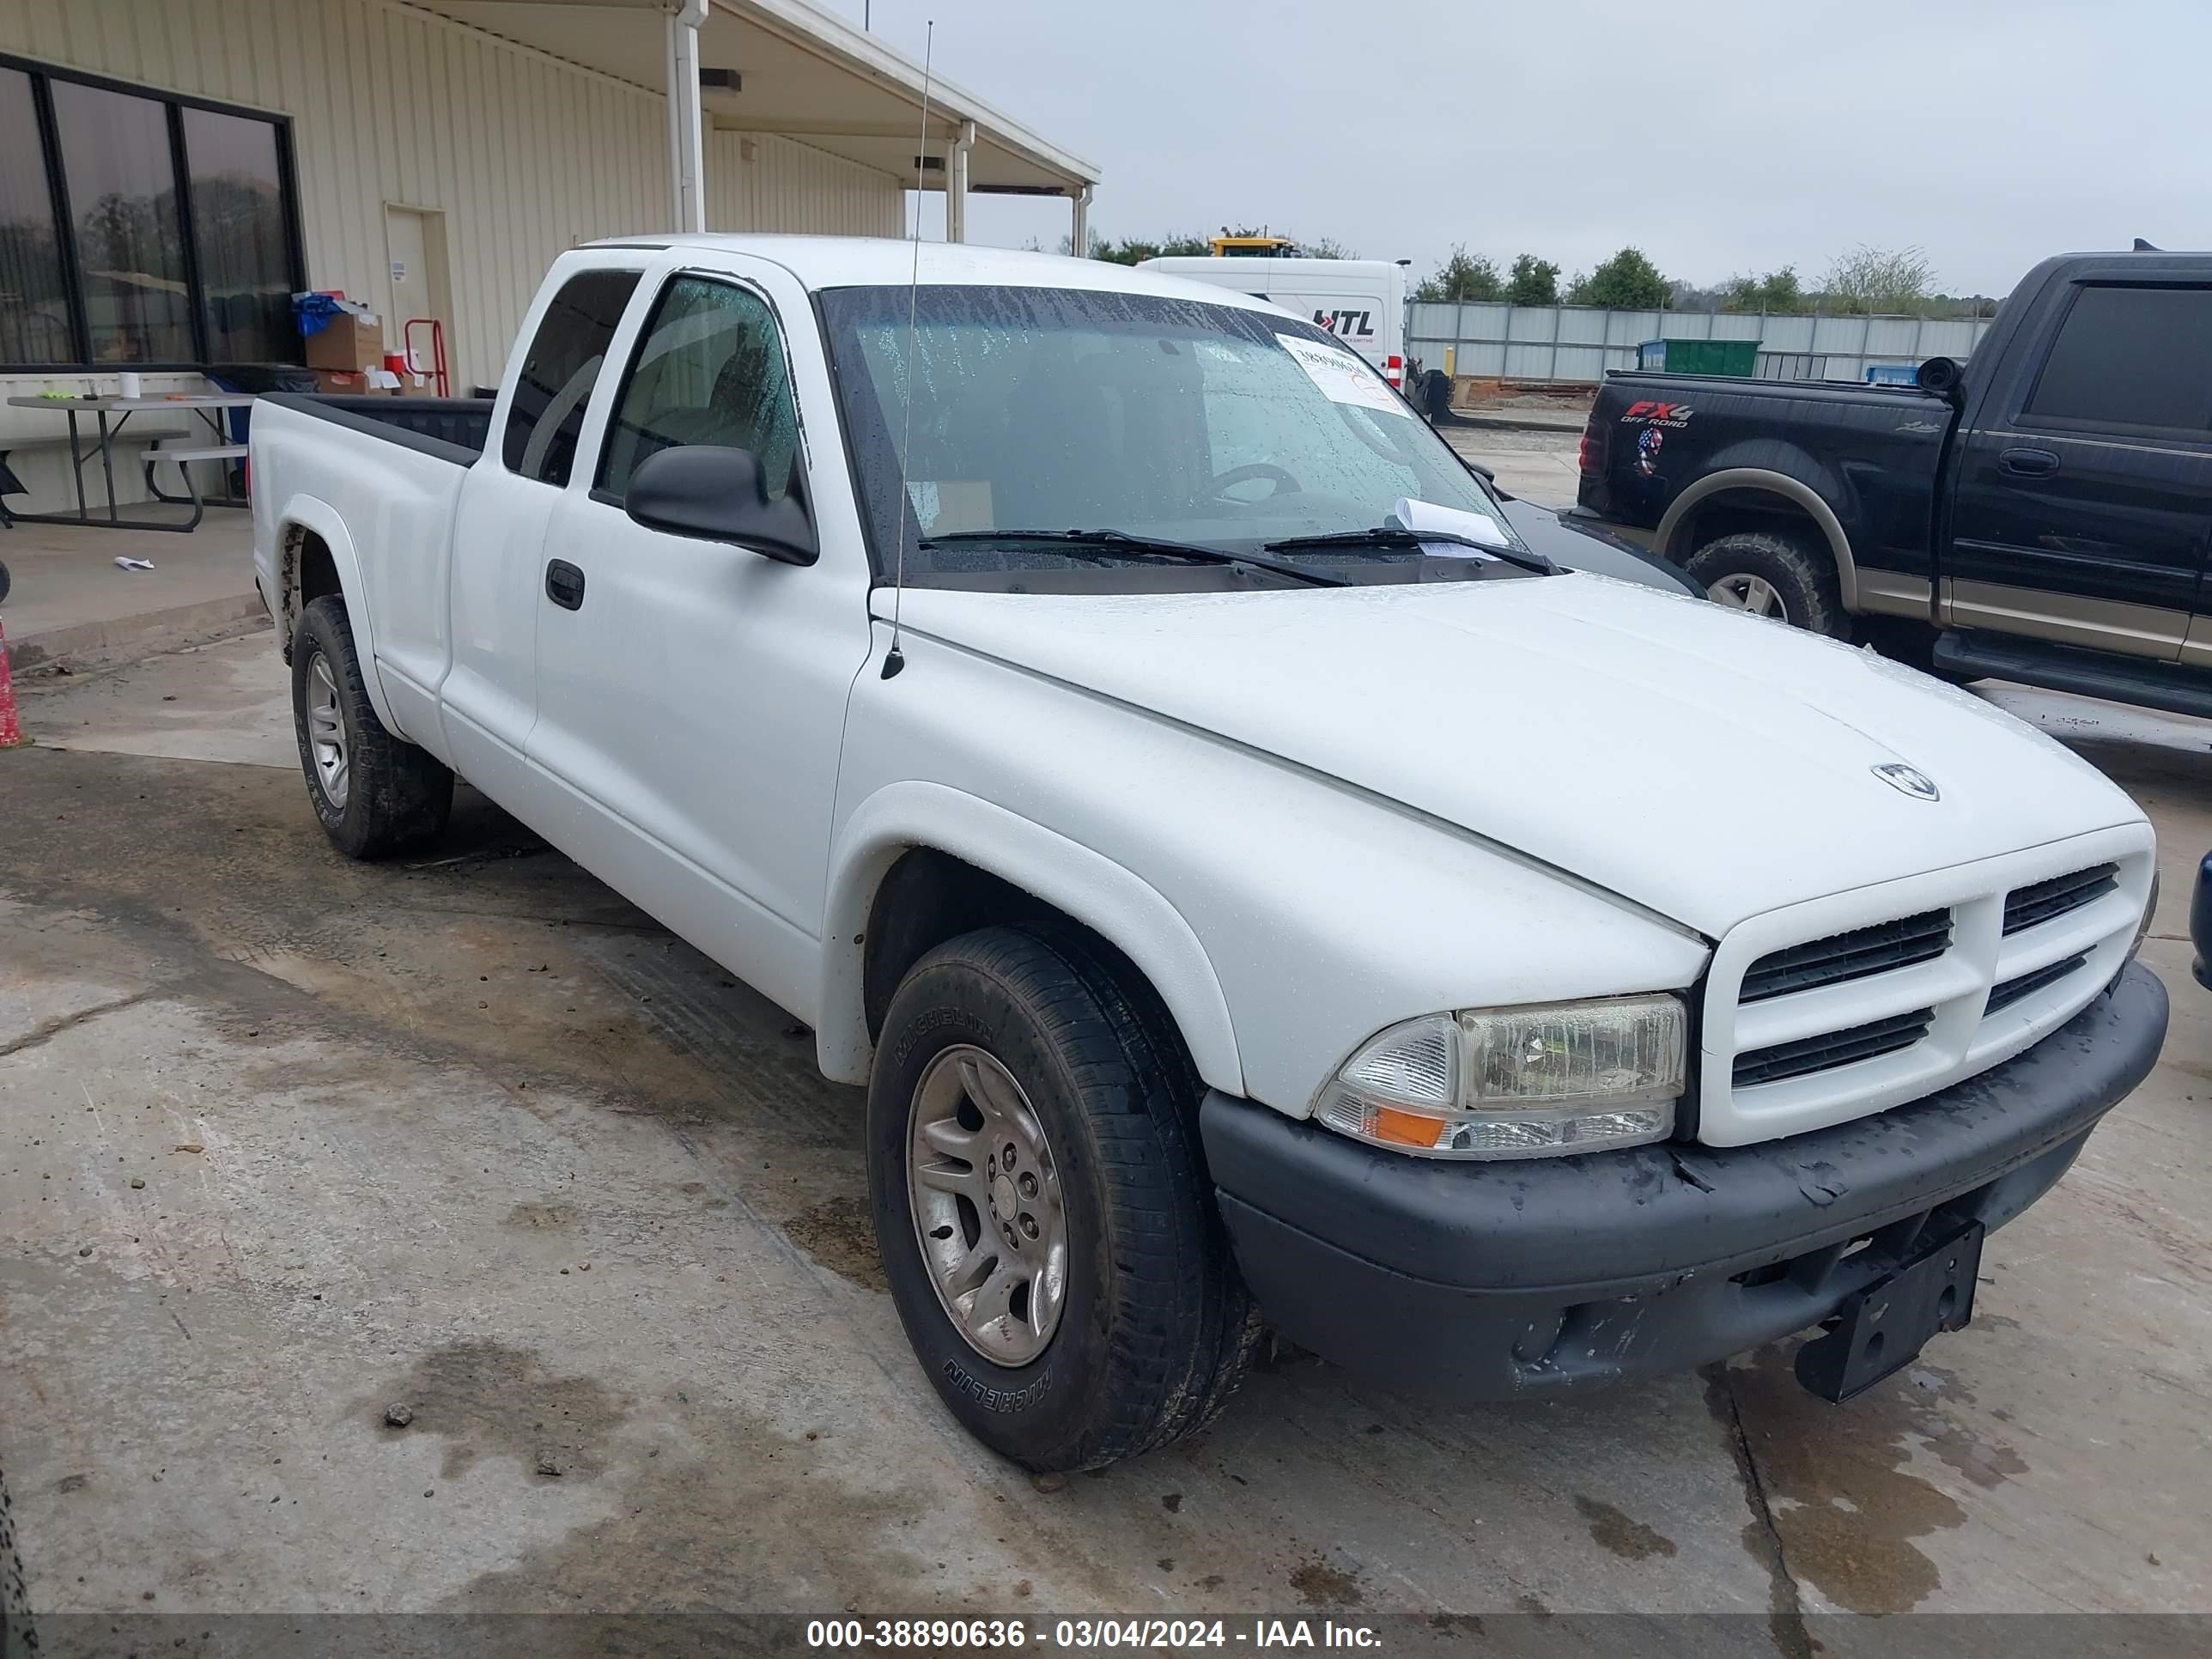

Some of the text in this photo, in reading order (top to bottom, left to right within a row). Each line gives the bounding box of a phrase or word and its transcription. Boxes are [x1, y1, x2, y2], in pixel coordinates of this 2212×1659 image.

[1626, 401, 1694, 421] FX4
[1649, 418, 1688, 428] ROAD
[944, 1358, 1053, 1413] MICHELIN
